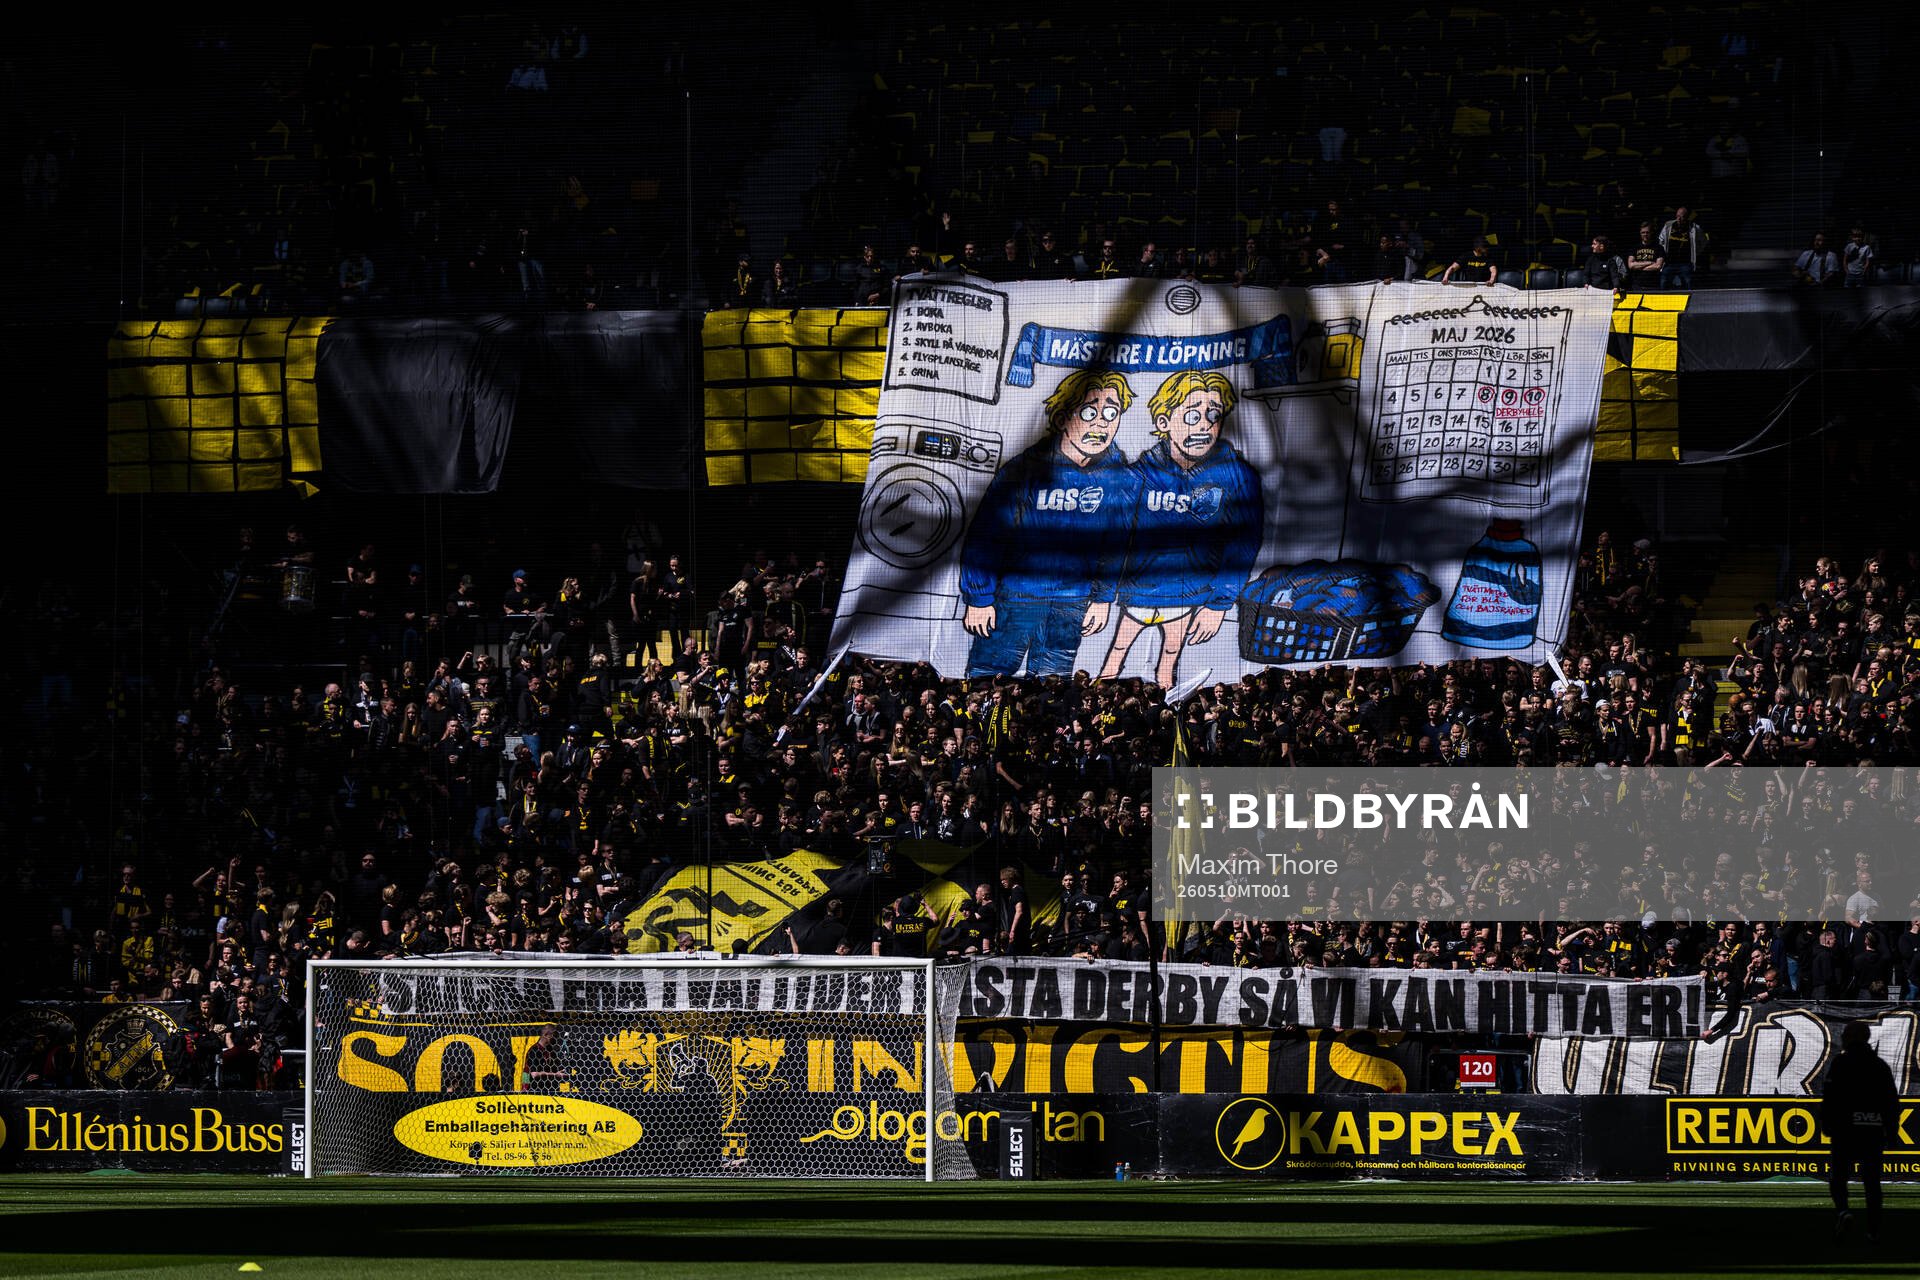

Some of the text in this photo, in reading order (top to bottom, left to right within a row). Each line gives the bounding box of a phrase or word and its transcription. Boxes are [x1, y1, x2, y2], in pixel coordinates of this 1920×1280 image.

[907, 287, 993, 312] TVÄTTREGLER
[905, 307, 944, 319] 1. BOKA
[902, 322, 953, 334] 2. AVBOKA
[1431, 326, 1516, 344] MAJ 2026
[902, 337, 1000, 361] 3. SKYLL PÅ VARANDRA
[1144, 345, 1154, 364] I
[1156, 338, 1246, 365] LÖPNING
[1414, 352, 1430, 360] TIS
[1437, 349, 1454, 358] ONS
[1456, 348, 1479, 358] TORS
[1506, 352, 1526, 361] LÖR
[1530, 351, 1549, 360] SÖN
[912, 352, 982, 374] FLYGPLANSLÄGE
[898, 368, 940, 381] 5. GRINA
[1486, 366, 1492, 378] 1
[1506, 368, 1517, 380] 2
[1533, 369, 1543, 380] 3
[1387, 391, 1397, 404] 4
[1410, 390, 1421, 402] 5
[1434, 387, 1443, 399] 6
[1455, 388, 1466, 400] 7
[1528, 390, 1542, 402] 10
[1496, 408, 1544, 417] DERBYHELG
[1384, 414, 1538, 434] 11 12 13 14 15 16 17
[1380, 436, 1540, 455] 18 19 20 21 22 23 24
[1376, 458, 1536, 477] 25 26 27 28 29 30 31
[1036, 488, 1079, 512] LGS
[1460, 595, 1478, 603] FÖR
[1455, 604, 1533, 616] OCH BAJSRÄNDER
[1073, 969, 1230, 1025] DERBY
[1238, 967, 1300, 1027] SÅ
[1311, 978, 1356, 1028] VI
[1370, 977, 1466, 1034] KAN
[1478, 980, 1614, 1036] HITTA
[1626, 984, 1702, 1038] ER!
[1462, 1061, 1493, 1076] 120
[476, 1101, 564, 1114] Sollentuna
[425, 1120, 616, 1136] Emballagehantering AB
[1290, 1112, 1524, 1156] KAPPEX
[291, 1122, 304, 1172] SELECT
[490, 1140, 516, 1150] Säljer
[1010, 1126, 1024, 1177] SELECT
[485, 1152, 502, 1160] Tel.
[504, 1152, 528, 1160] 08-96
[542, 1152, 552, 1160] 56
[1286, 1160, 1526, 1171] Skräddarsydda, lönsamma och hållbara kontorslösningar
[1674, 1162, 1737, 1172] RIVNING
[1743, 1162, 1819, 1173] SANERING
